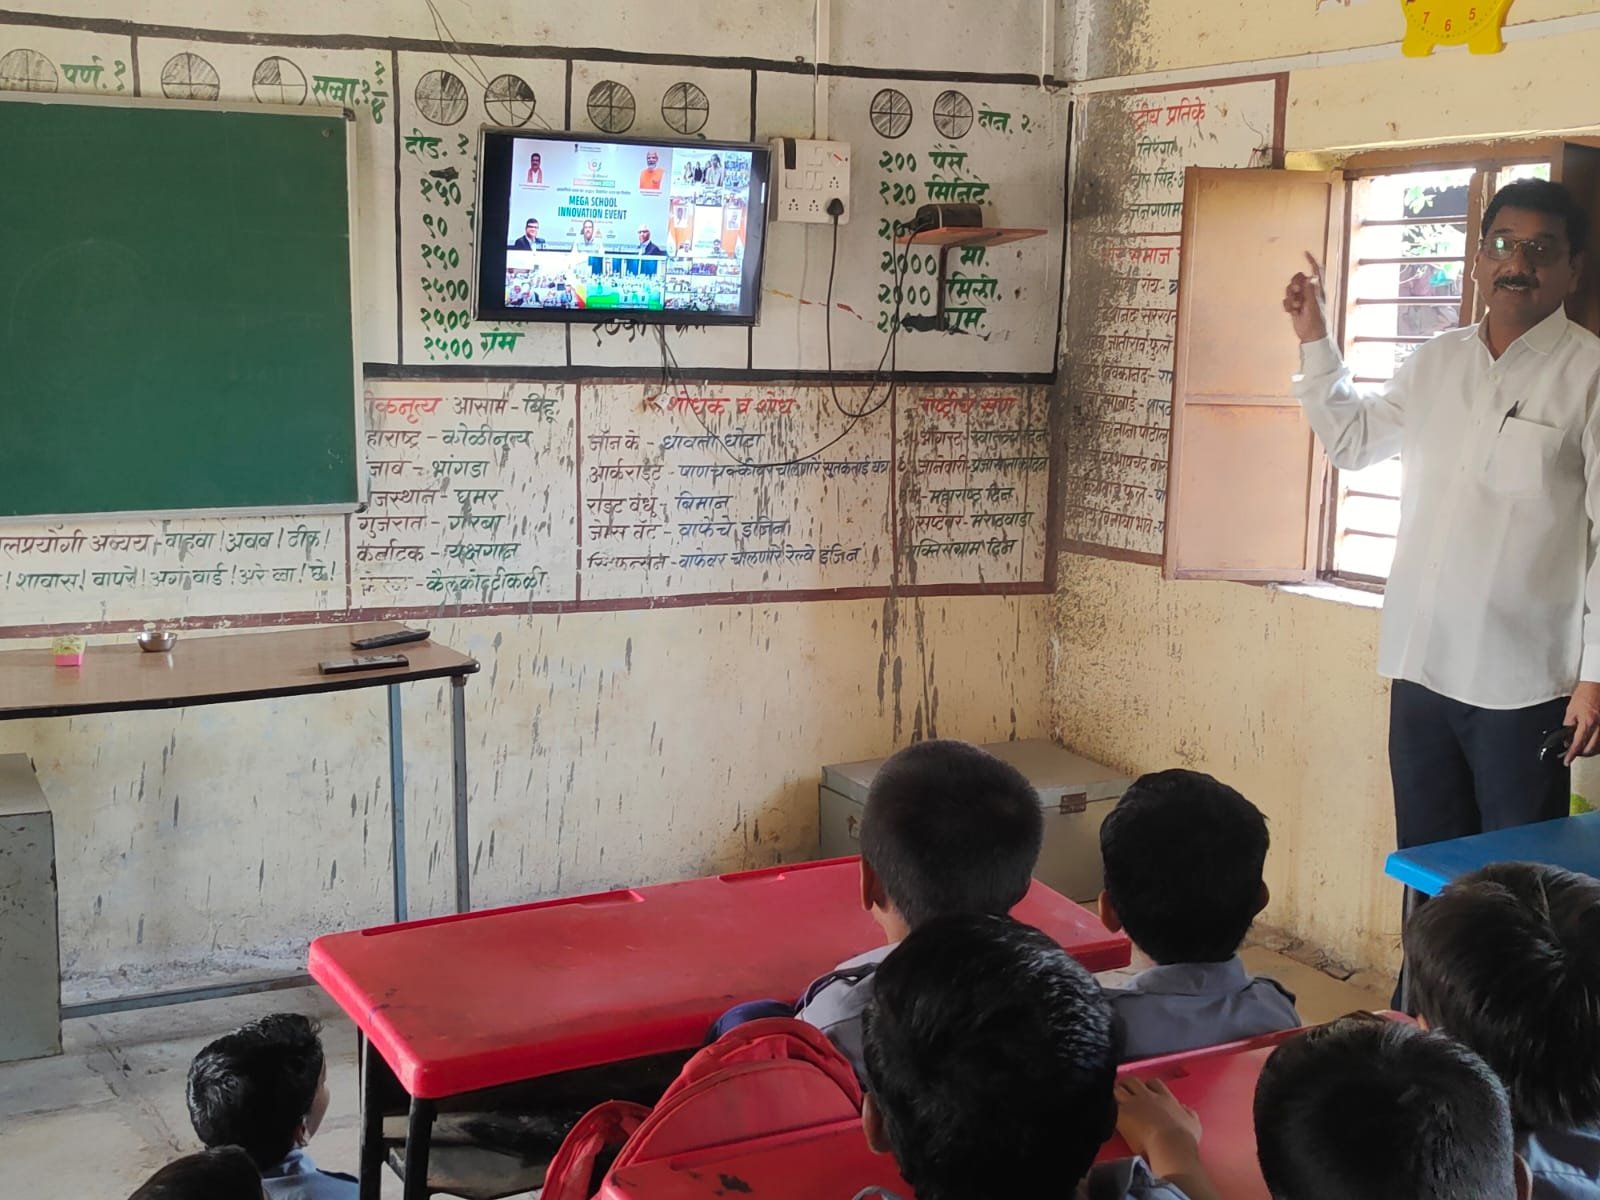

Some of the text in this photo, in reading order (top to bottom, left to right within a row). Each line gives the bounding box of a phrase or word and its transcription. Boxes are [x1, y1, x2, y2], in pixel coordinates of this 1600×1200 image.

[1422, 8, 1476, 32] 7 6 5
[878, 150, 917, 173] २००
[557, 206, 627, 220] INNOVATION EVENT
[568, 195, 618, 208] MEGA SCHOOL
[880, 250, 938, 275] २०००
[878, 283, 931, 306] २०००
[452, 396, 509, 417] आसाम
[364, 430, 422, 449] हाराष्ट्र
[356, 514, 428, 539] गुजरात
